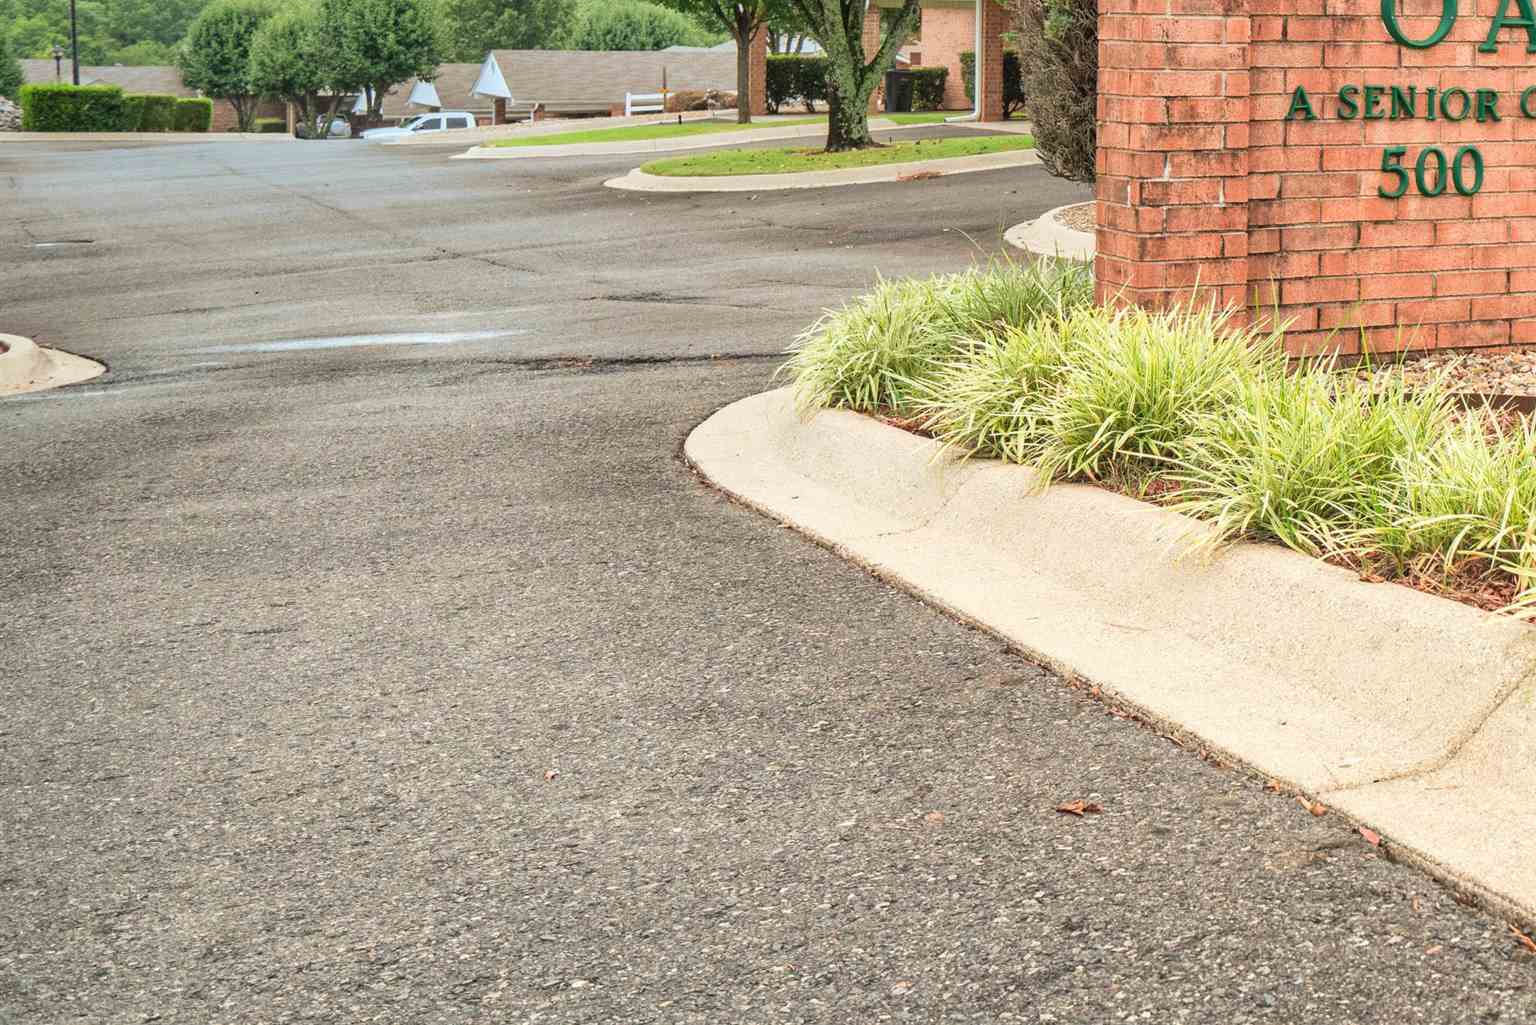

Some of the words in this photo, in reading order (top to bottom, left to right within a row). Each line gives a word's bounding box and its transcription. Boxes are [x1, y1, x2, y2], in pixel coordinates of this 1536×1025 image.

[1285, 84, 1316, 121] A
[1337, 84, 1501, 122] SENIOR
[1377, 144, 1485, 198] 500
